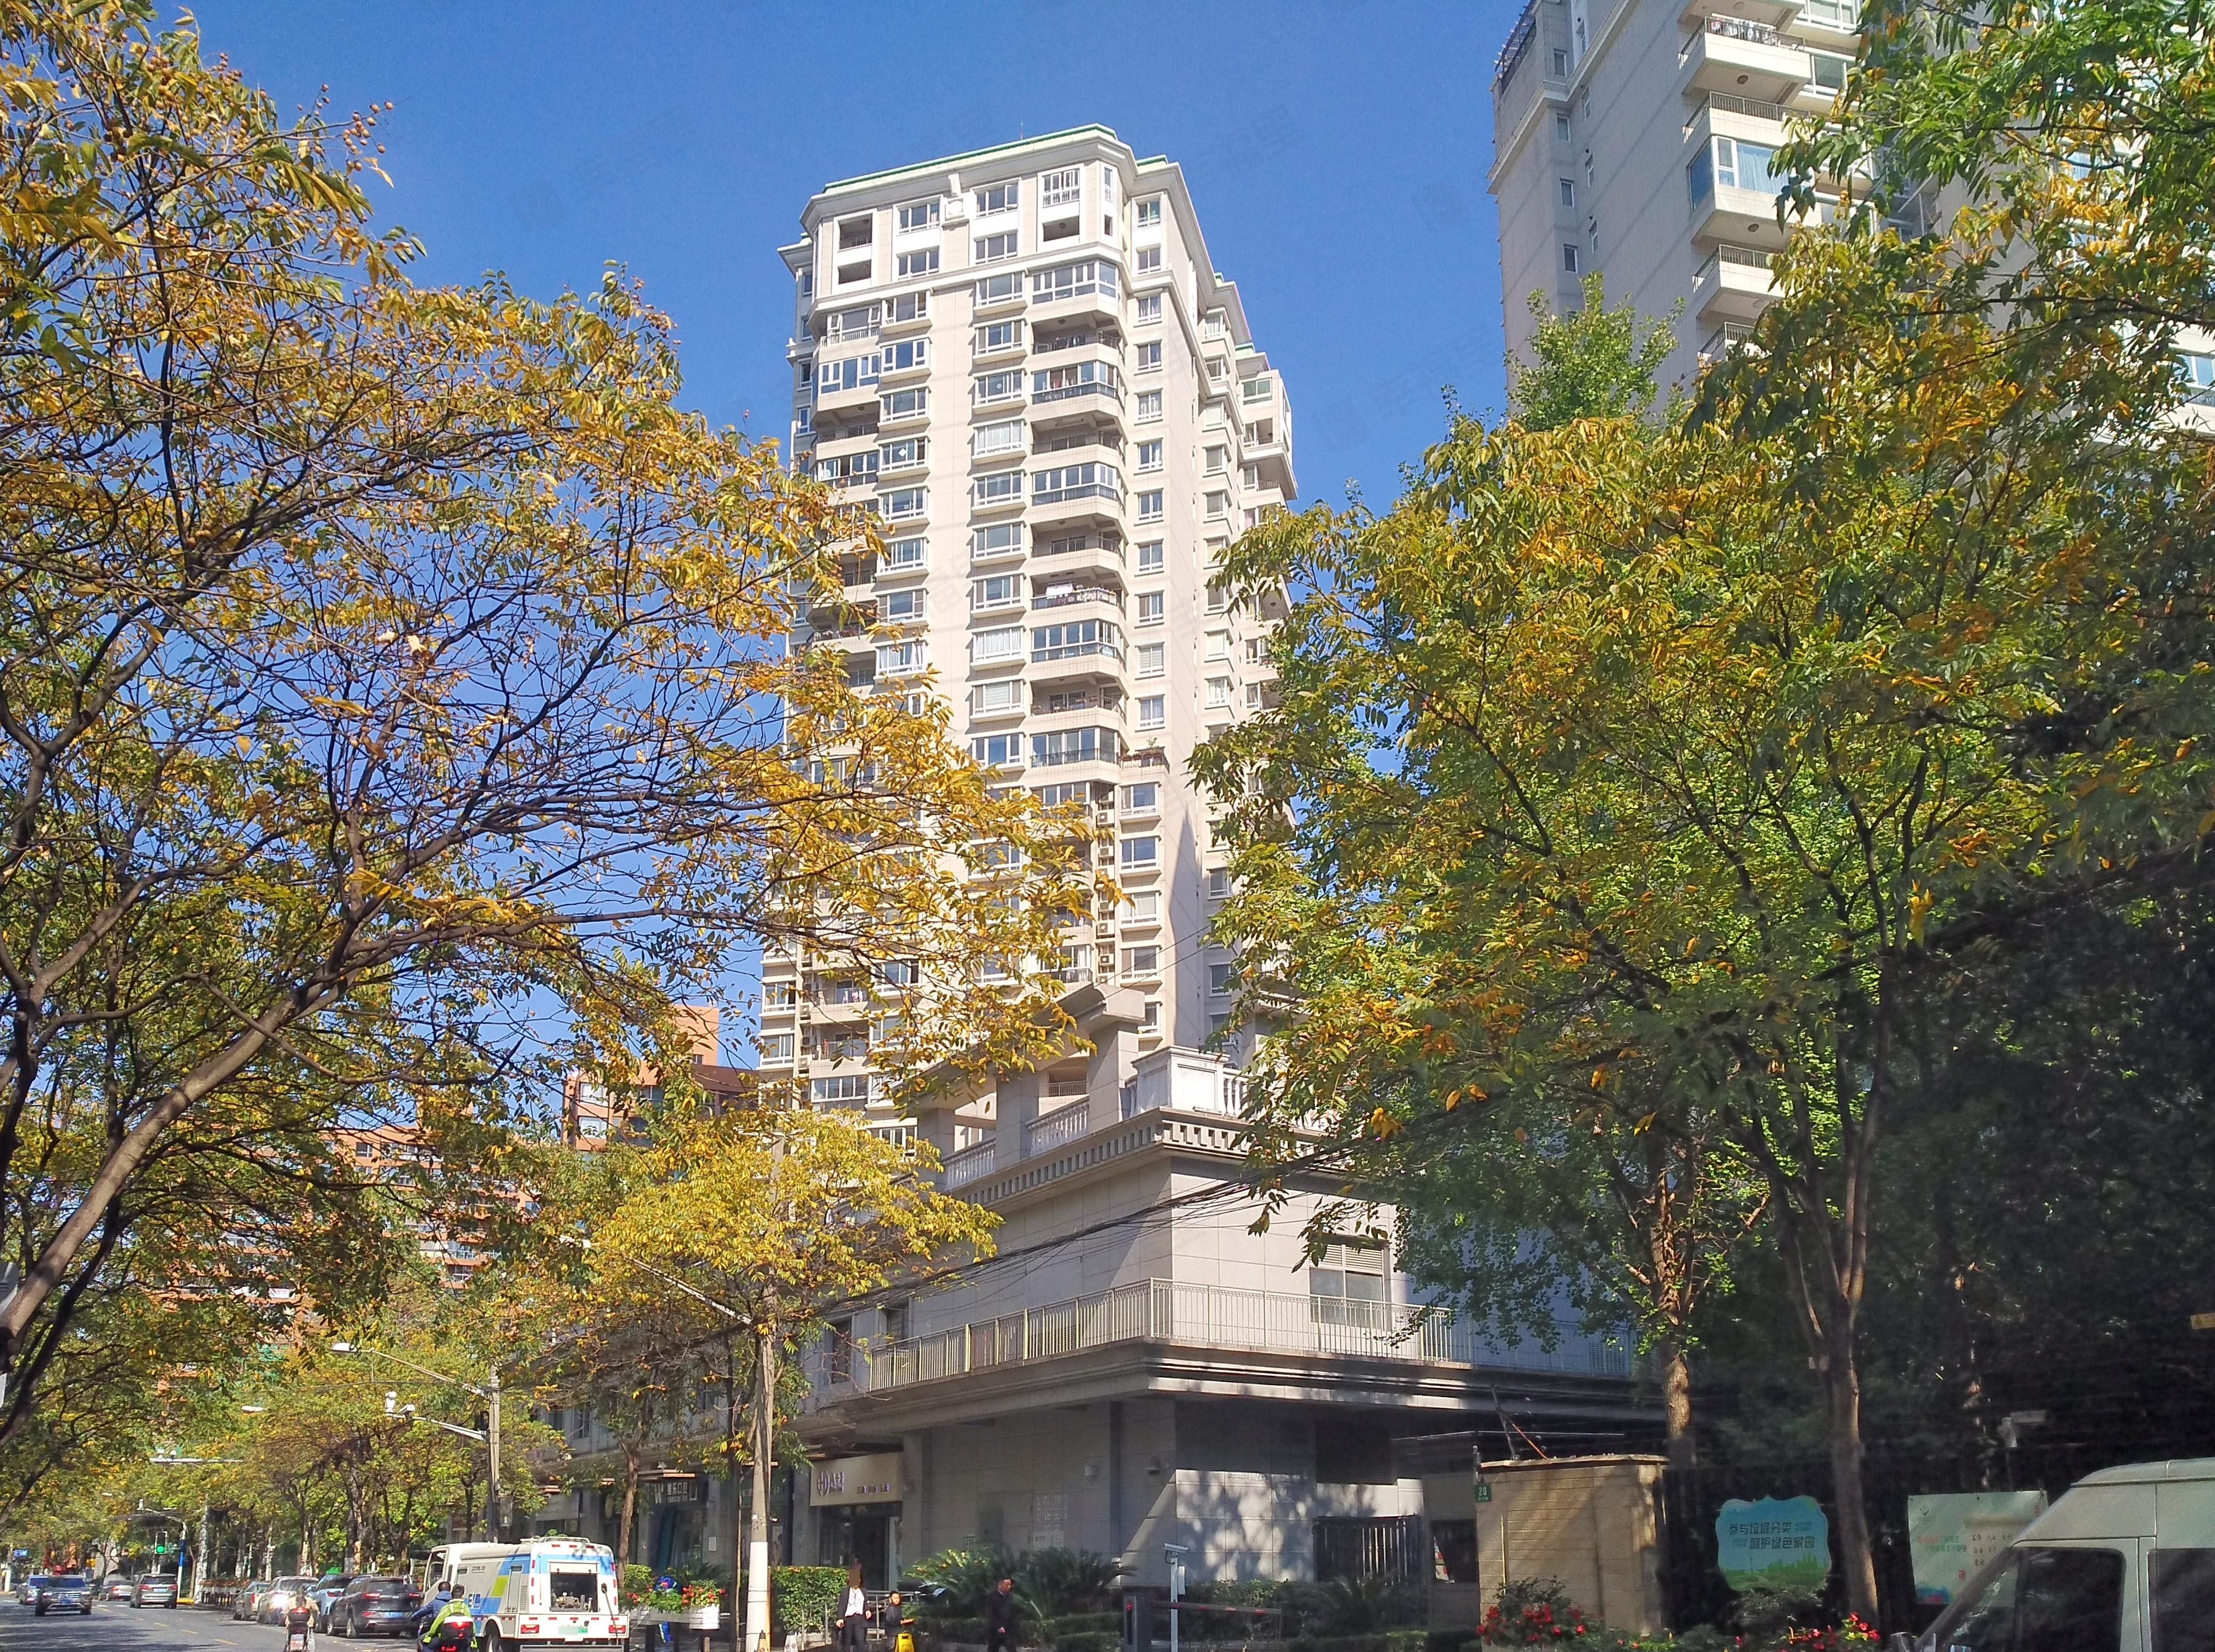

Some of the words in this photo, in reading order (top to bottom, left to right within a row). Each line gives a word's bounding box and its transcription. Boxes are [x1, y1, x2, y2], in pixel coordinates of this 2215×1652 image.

[1479, 1487, 1487, 1495] 20
[1729, 1521, 1792, 1536] 参与垃圾分类
[1750, 1536, 1815, 1549] 呵护绿色家园
